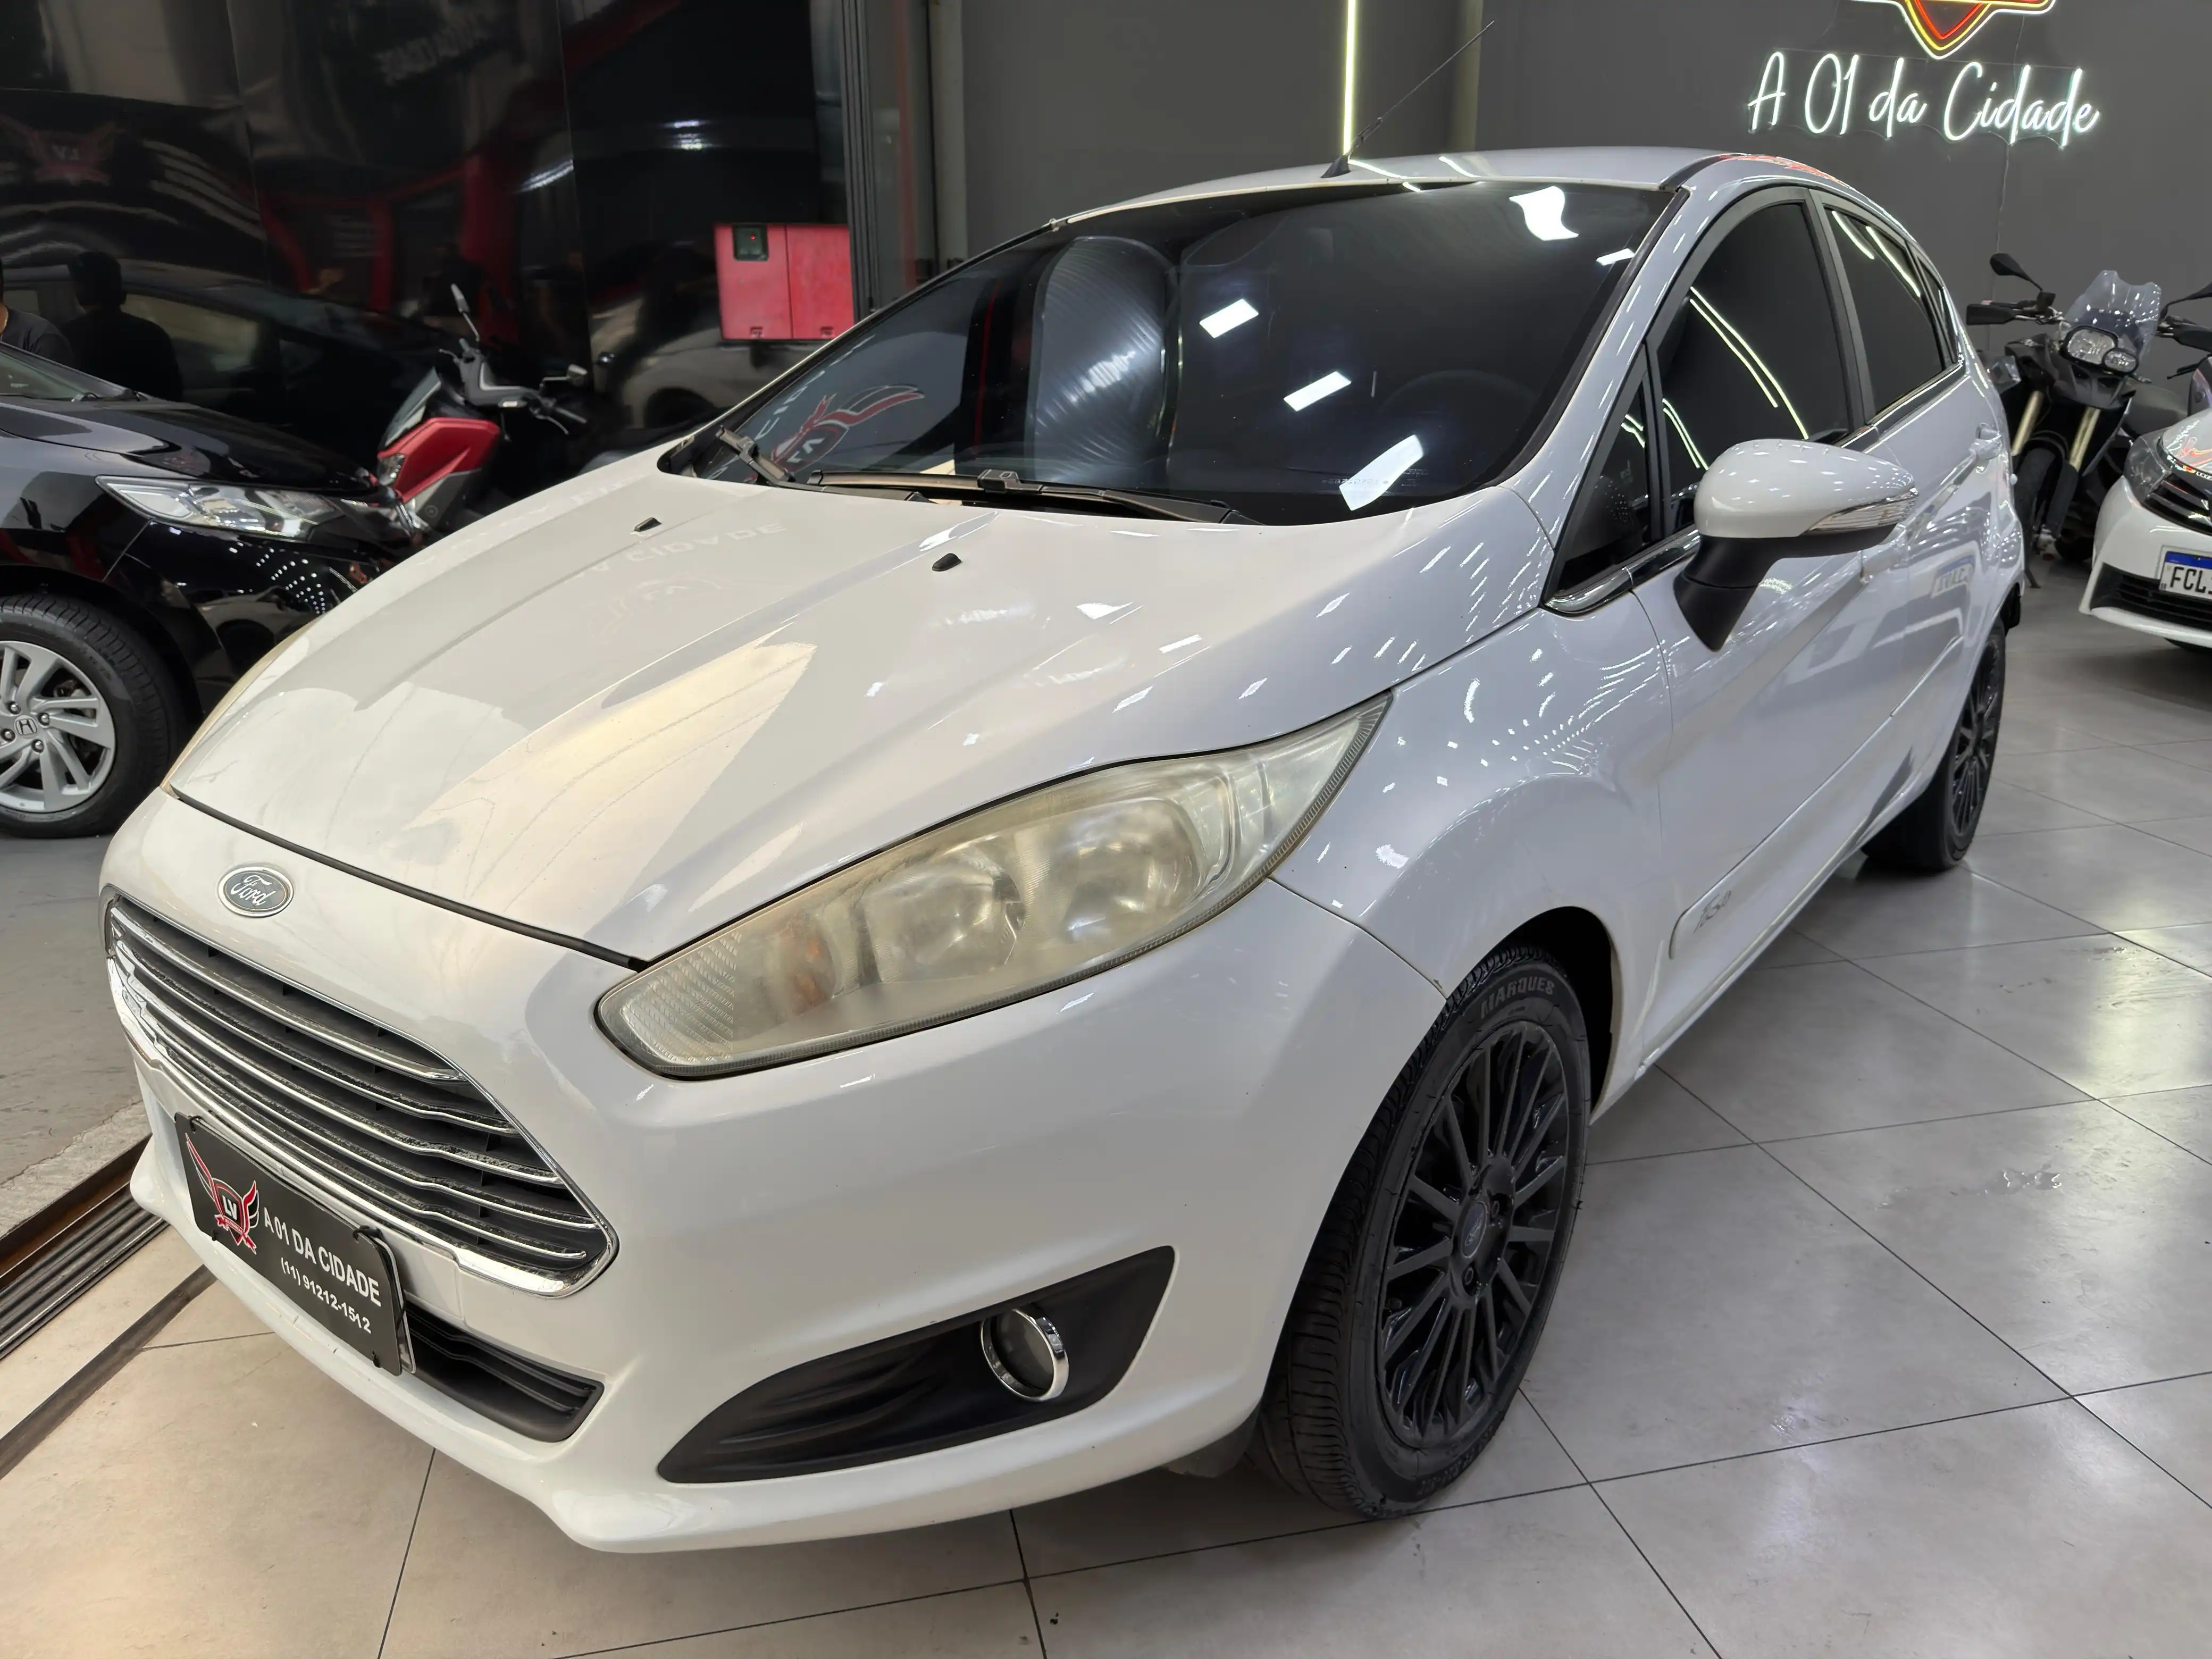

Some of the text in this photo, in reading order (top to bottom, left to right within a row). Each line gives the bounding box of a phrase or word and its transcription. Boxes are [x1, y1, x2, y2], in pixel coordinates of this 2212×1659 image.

[1748, 52, 1786, 131] A
[1869, 57, 1928, 138] da
[1943, 61, 2101, 147] Cidade
[2169, 566, 2212, 594] FCL
[230, 875, 276, 906] Ford
[222, 1195, 237, 1221] LV
[264, 1206, 274, 1234] A
[274, 1216, 290, 1246] 01
[292, 1228, 317, 1264] DA
[319, 1246, 381, 1308] CIDADE
[281, 1256, 371, 1334] (11) 91212-1512
